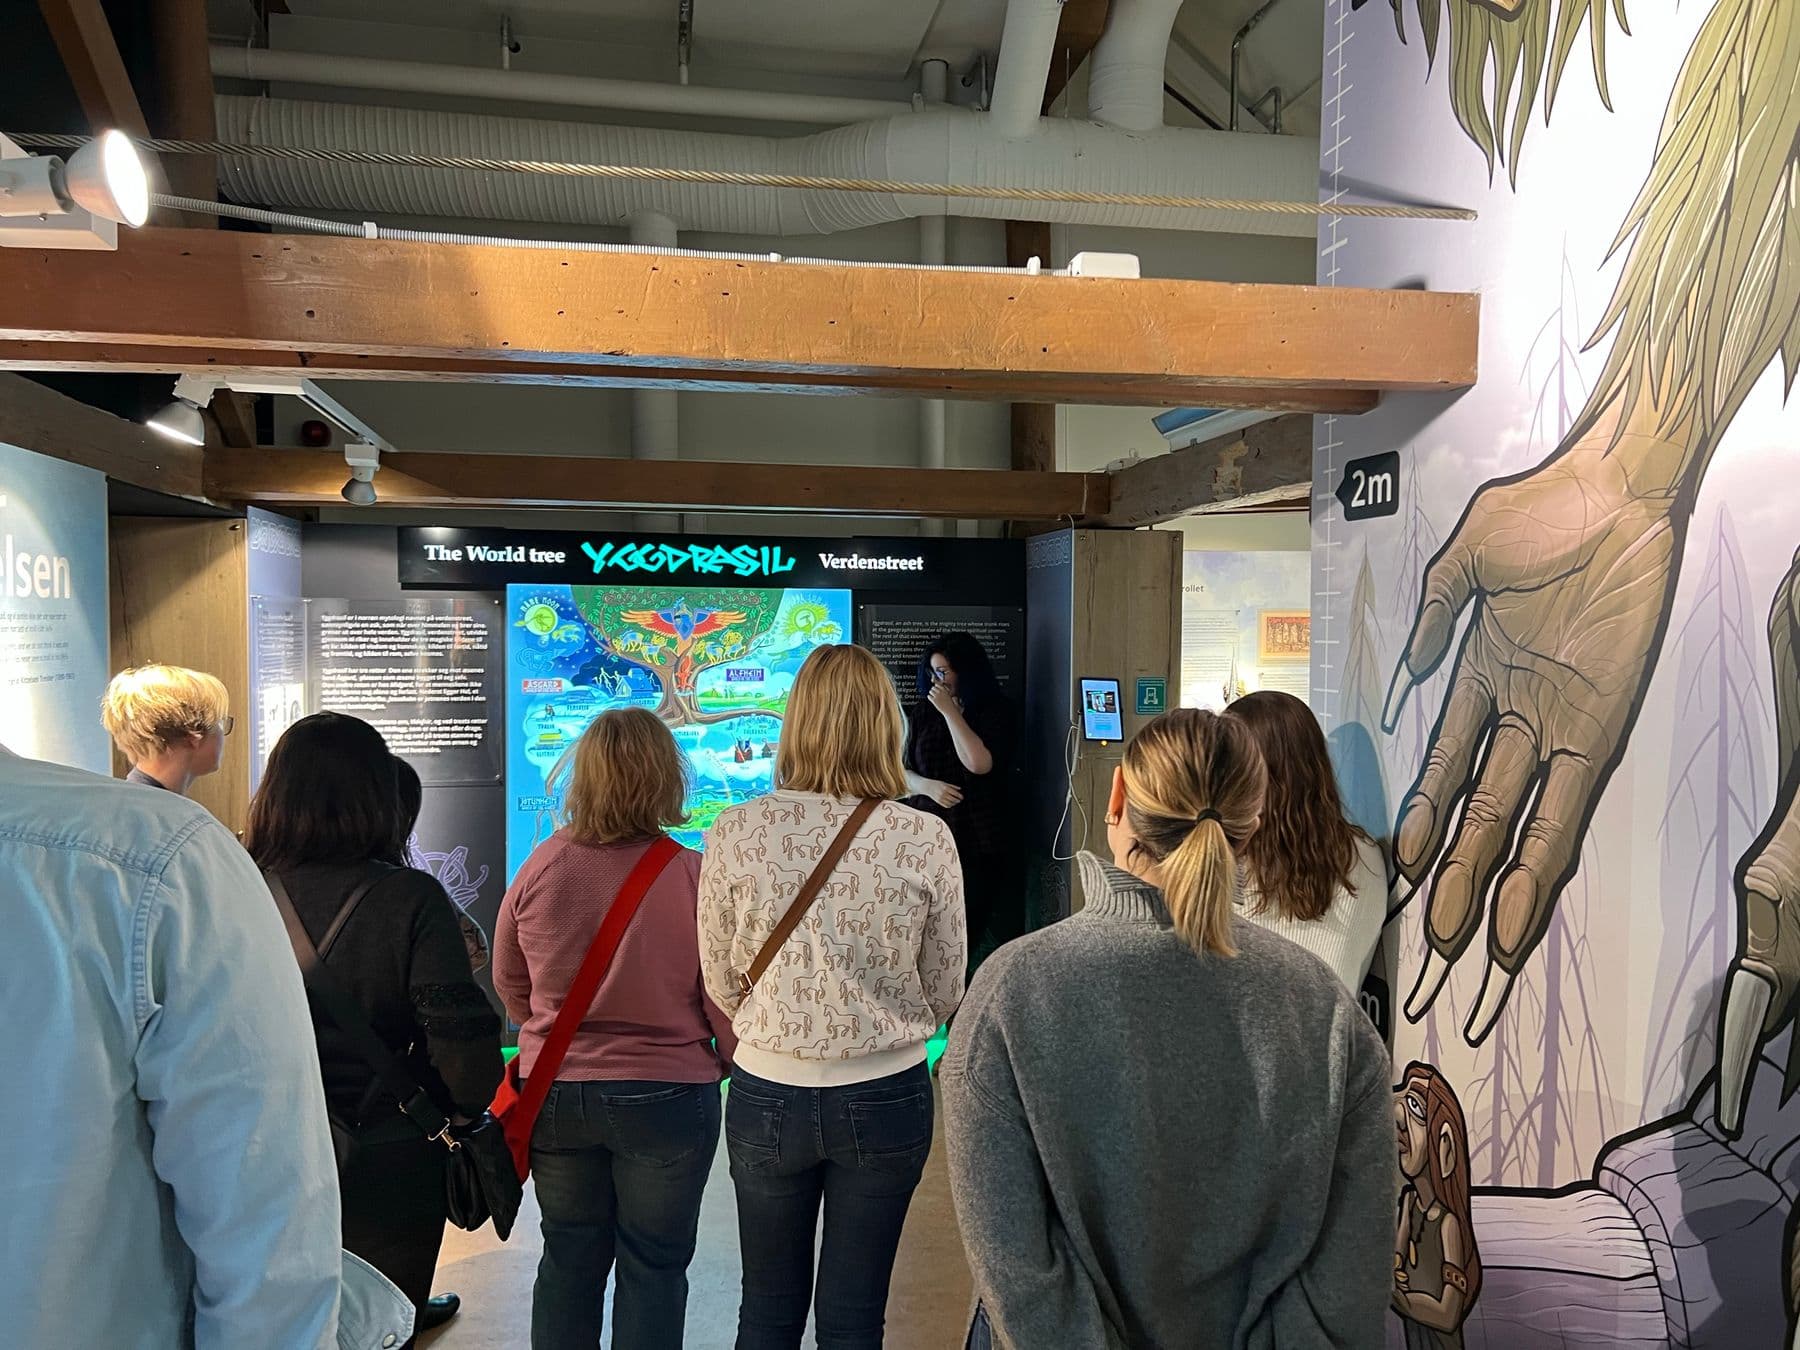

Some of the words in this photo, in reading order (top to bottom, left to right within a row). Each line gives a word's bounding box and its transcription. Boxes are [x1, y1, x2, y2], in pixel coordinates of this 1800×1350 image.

[1351, 470, 1392, 507] 2m
[0, 534, 70, 599] lsen
[424, 544, 462, 562] The
[465, 544, 526, 563] World
[529, 548, 566, 564] tree
[581, 542, 796, 576] YGGDRASIL
[818, 553, 924, 571] Verdenstreet
[1360, 991, 1380, 1026] m
